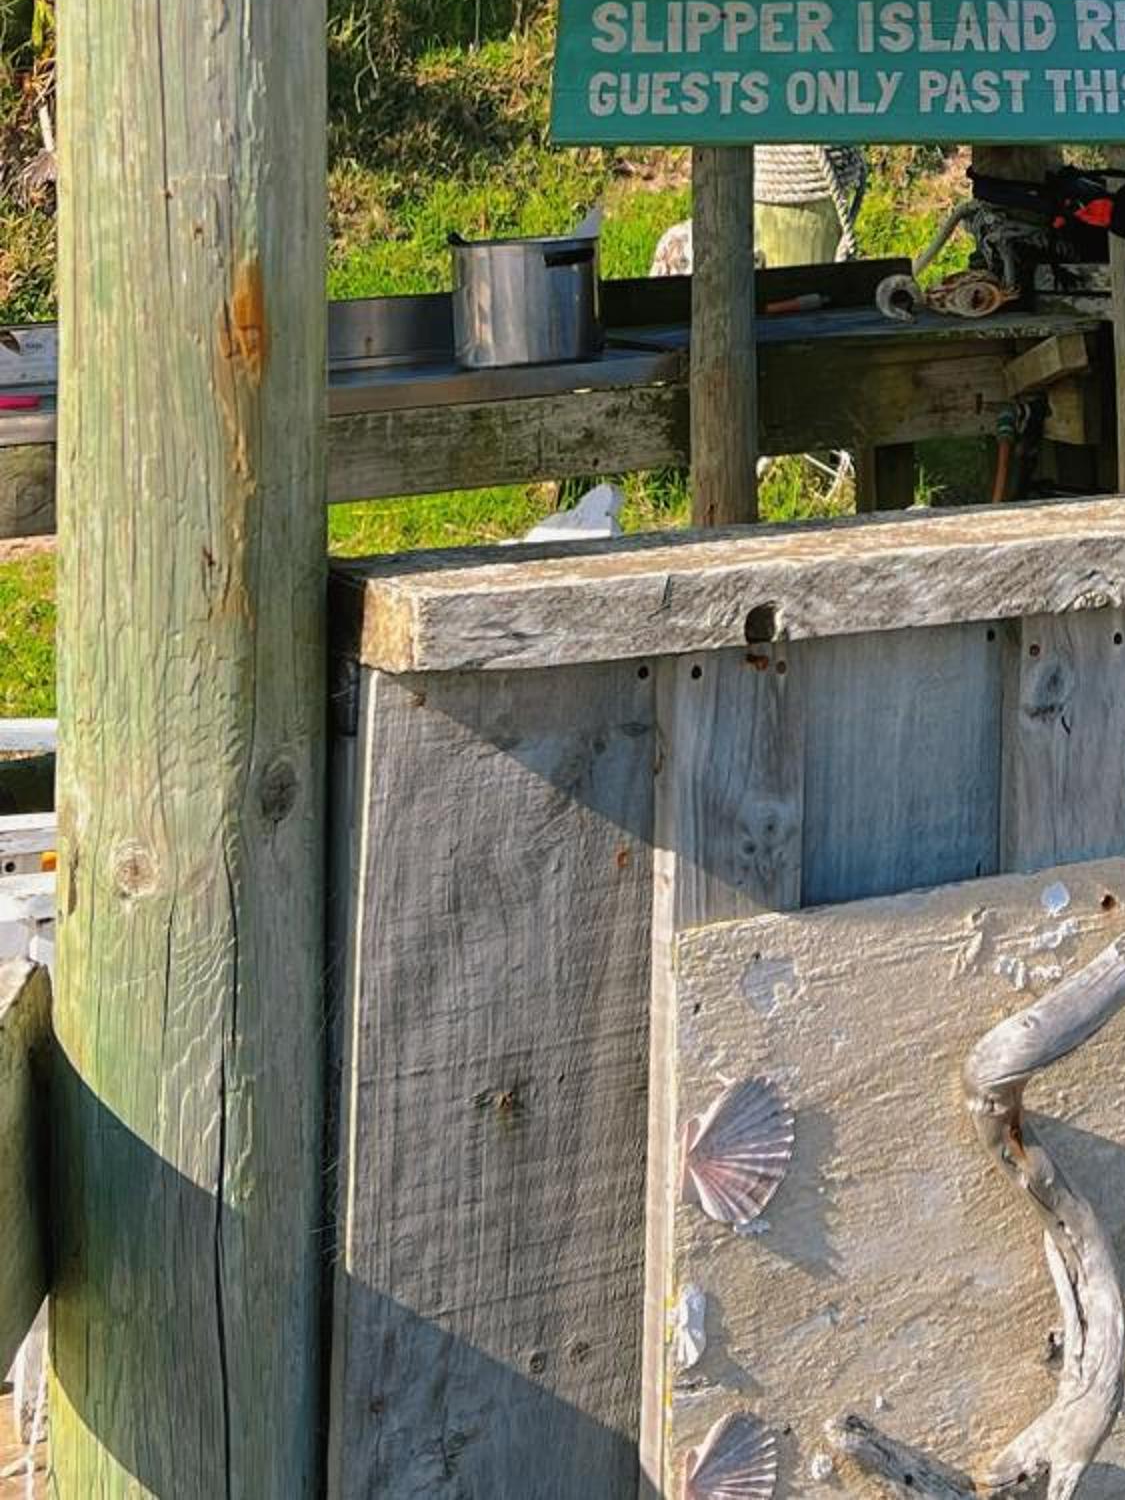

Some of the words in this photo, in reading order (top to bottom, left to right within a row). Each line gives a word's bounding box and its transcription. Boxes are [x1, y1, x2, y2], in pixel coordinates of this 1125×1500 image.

[590, 1, 834, 55] SLIPPER
[588, 70, 769, 116] GUESTS
[786, 70, 904, 115] ONLY
[919, 68, 1028, 114] PAST
